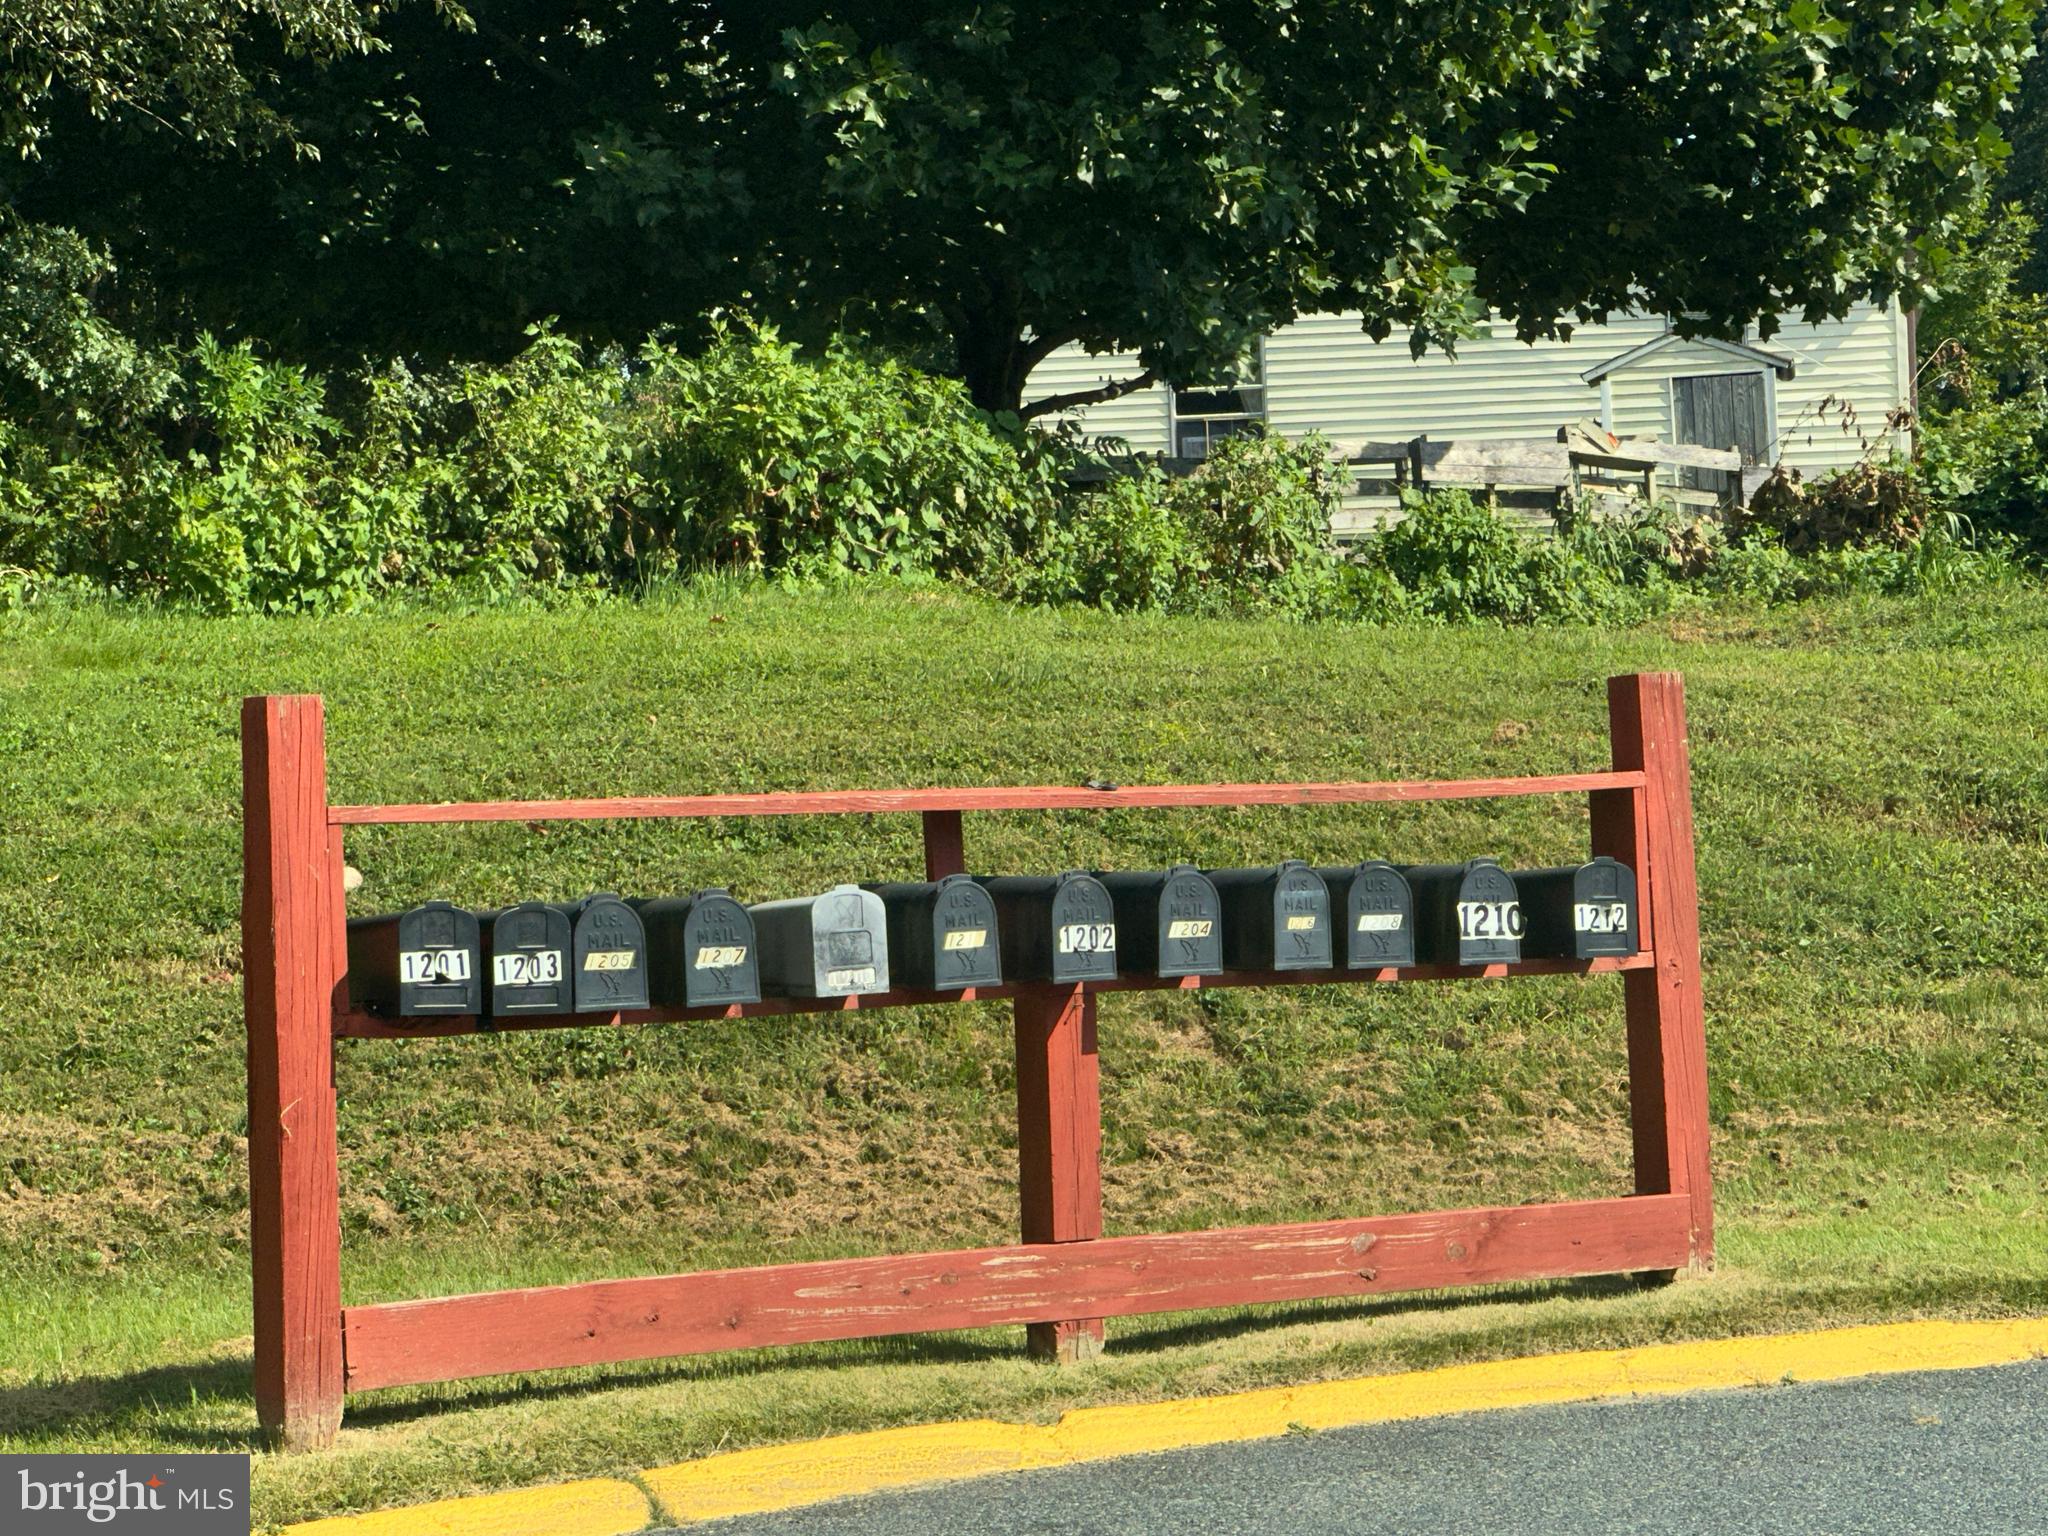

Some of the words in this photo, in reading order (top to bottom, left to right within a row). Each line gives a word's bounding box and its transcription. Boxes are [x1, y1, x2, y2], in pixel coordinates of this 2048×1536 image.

[1170, 902, 1207, 917] MAIL
[1284, 898, 1317, 911] MAIL
[1360, 896, 1400, 910] MAIL
[944, 913, 983, 927] MAIL
[1063, 908, 1100, 922] MAIL
[1461, 904, 1526, 937] 1210
[1579, 906, 1625, 929] 1212
[587, 933, 631, 948] MAIL
[697, 928, 741, 943] MAIL
[1064, 926, 1113, 950] 1202
[588, 953, 631, 968] 1205
[702, 948, 744, 963] 1207
[406, 952, 465, 979] 1201
[500, 953, 558, 981] 1203
